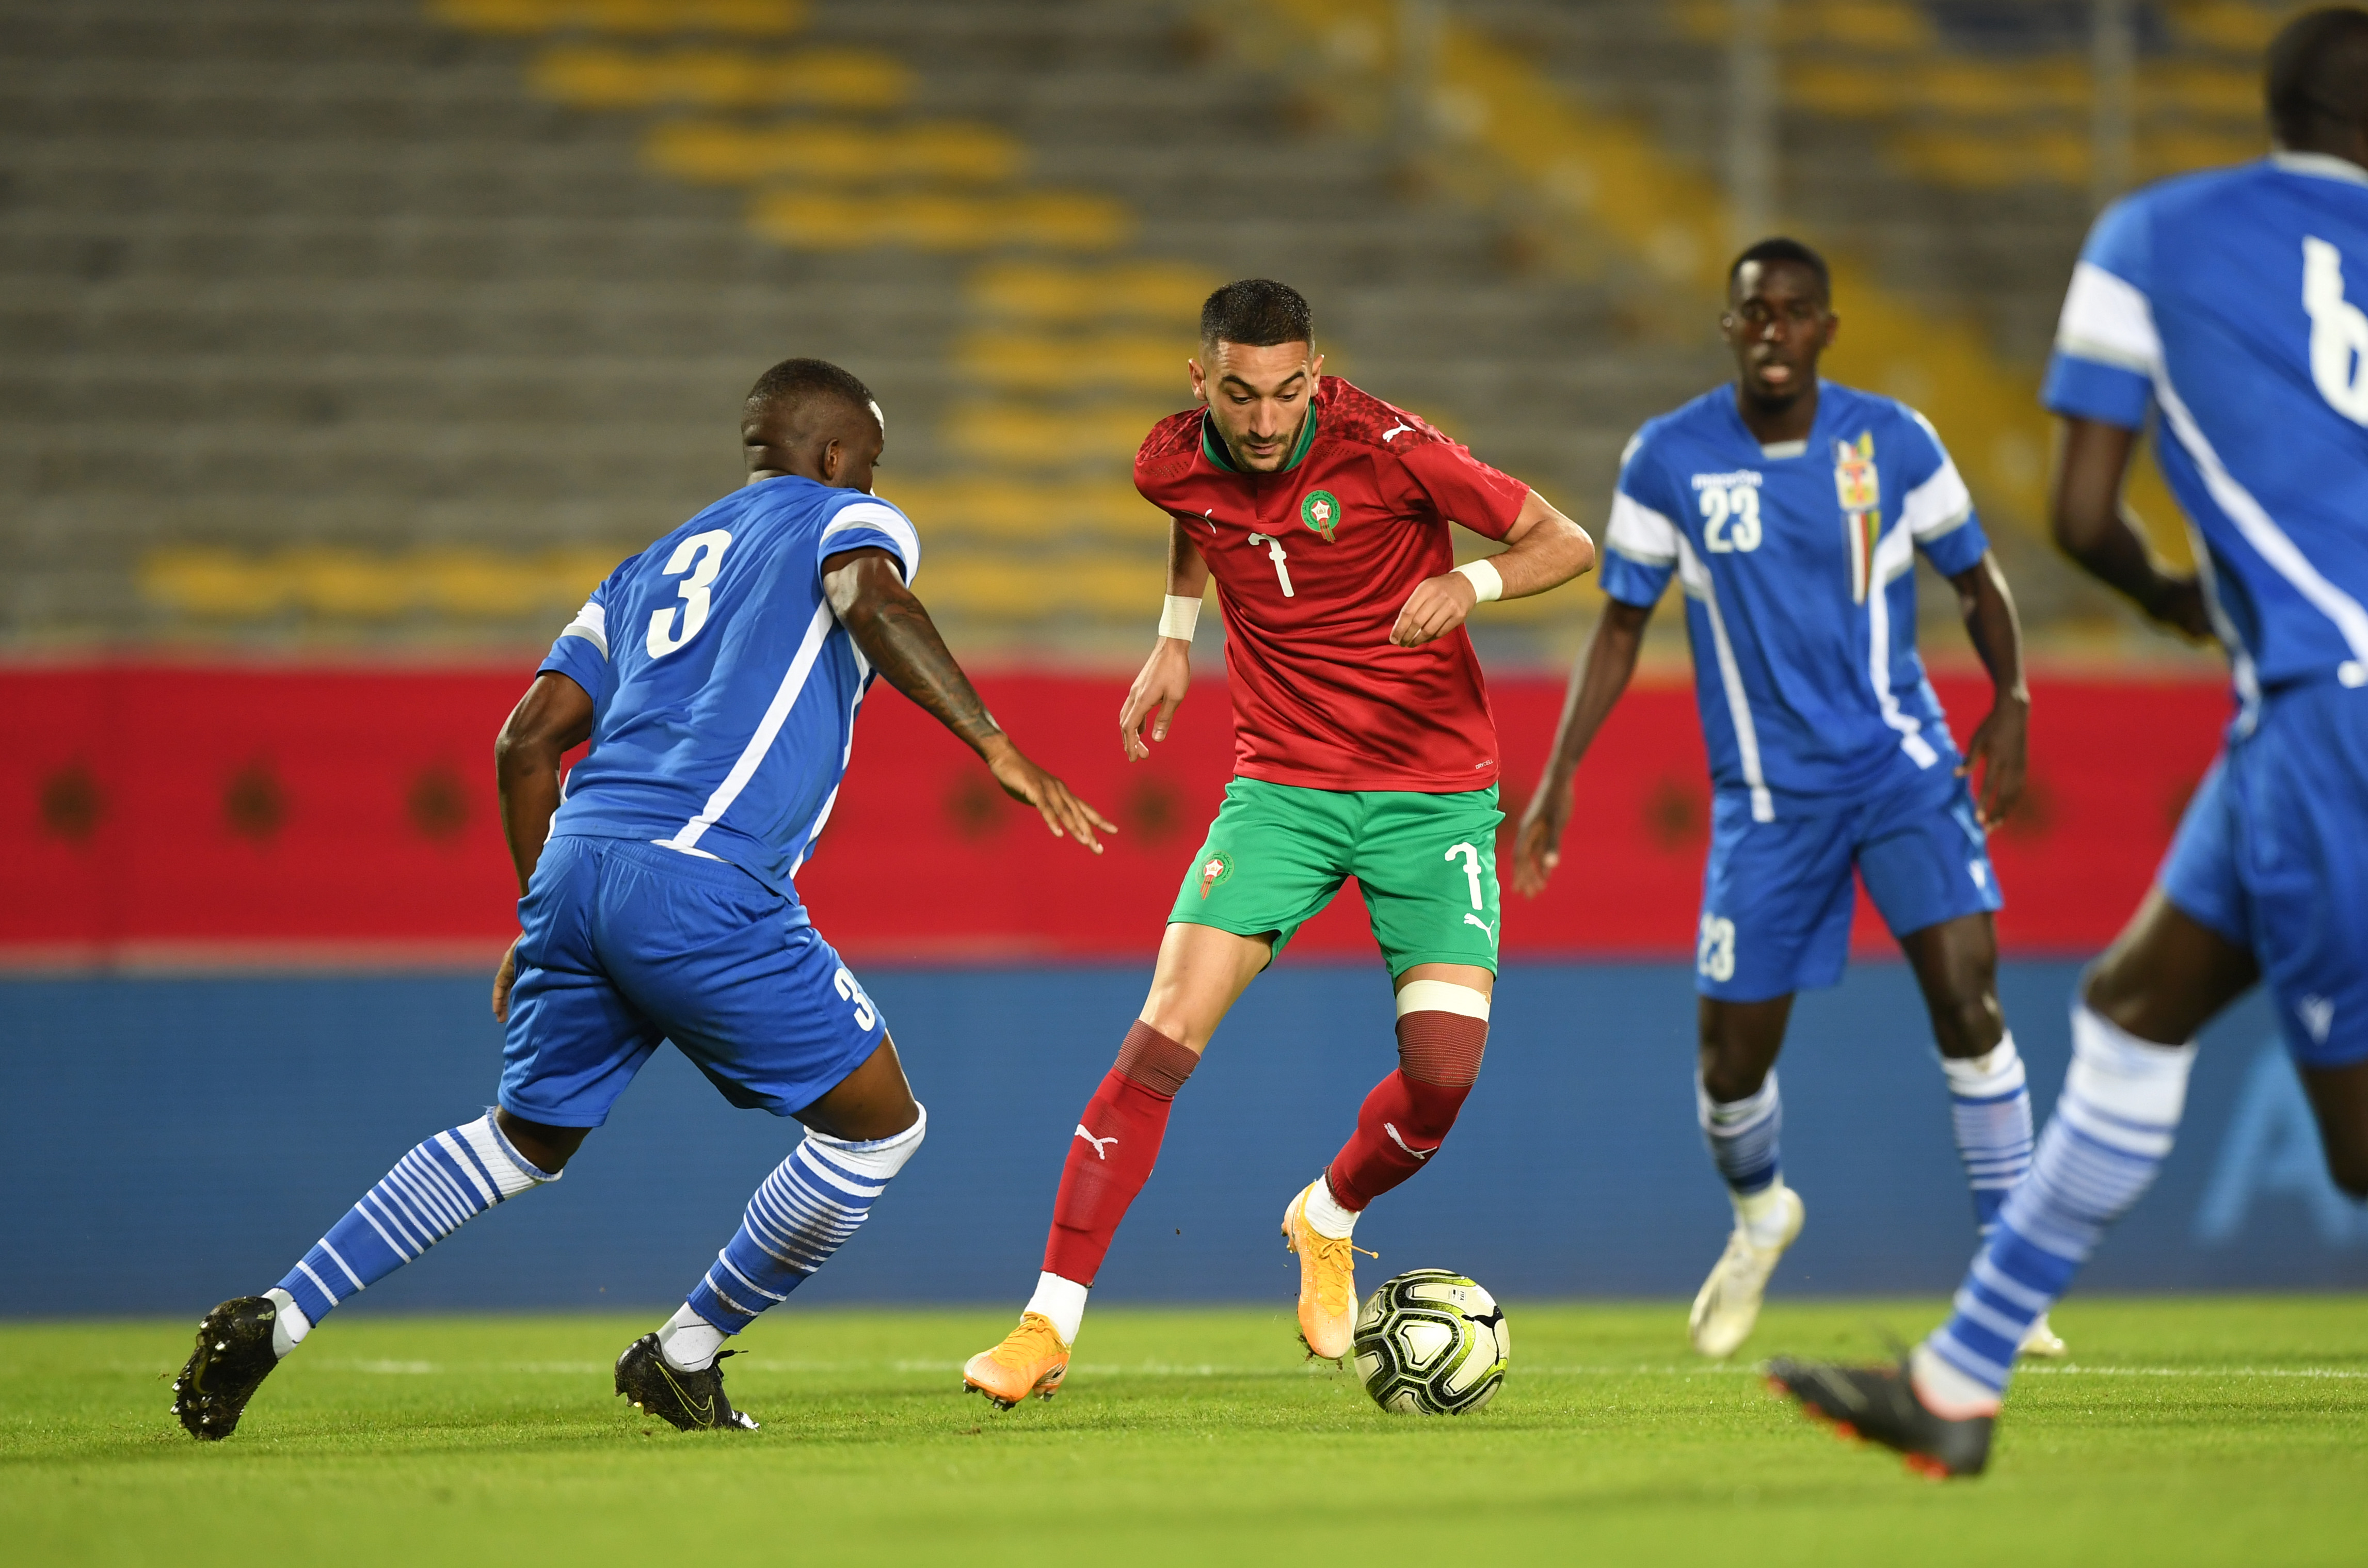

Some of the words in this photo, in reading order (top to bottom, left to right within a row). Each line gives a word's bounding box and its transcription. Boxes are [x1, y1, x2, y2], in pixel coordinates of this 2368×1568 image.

[2302, 235, 2368, 428] 6
[1699, 486, 1762, 553] 23
[646, 529, 732, 659] 3
[1247, 532, 1294, 598] 7
[1445, 842, 1483, 910] 7
[1697, 913, 1735, 982] 23
[834, 965, 876, 1032] 3
